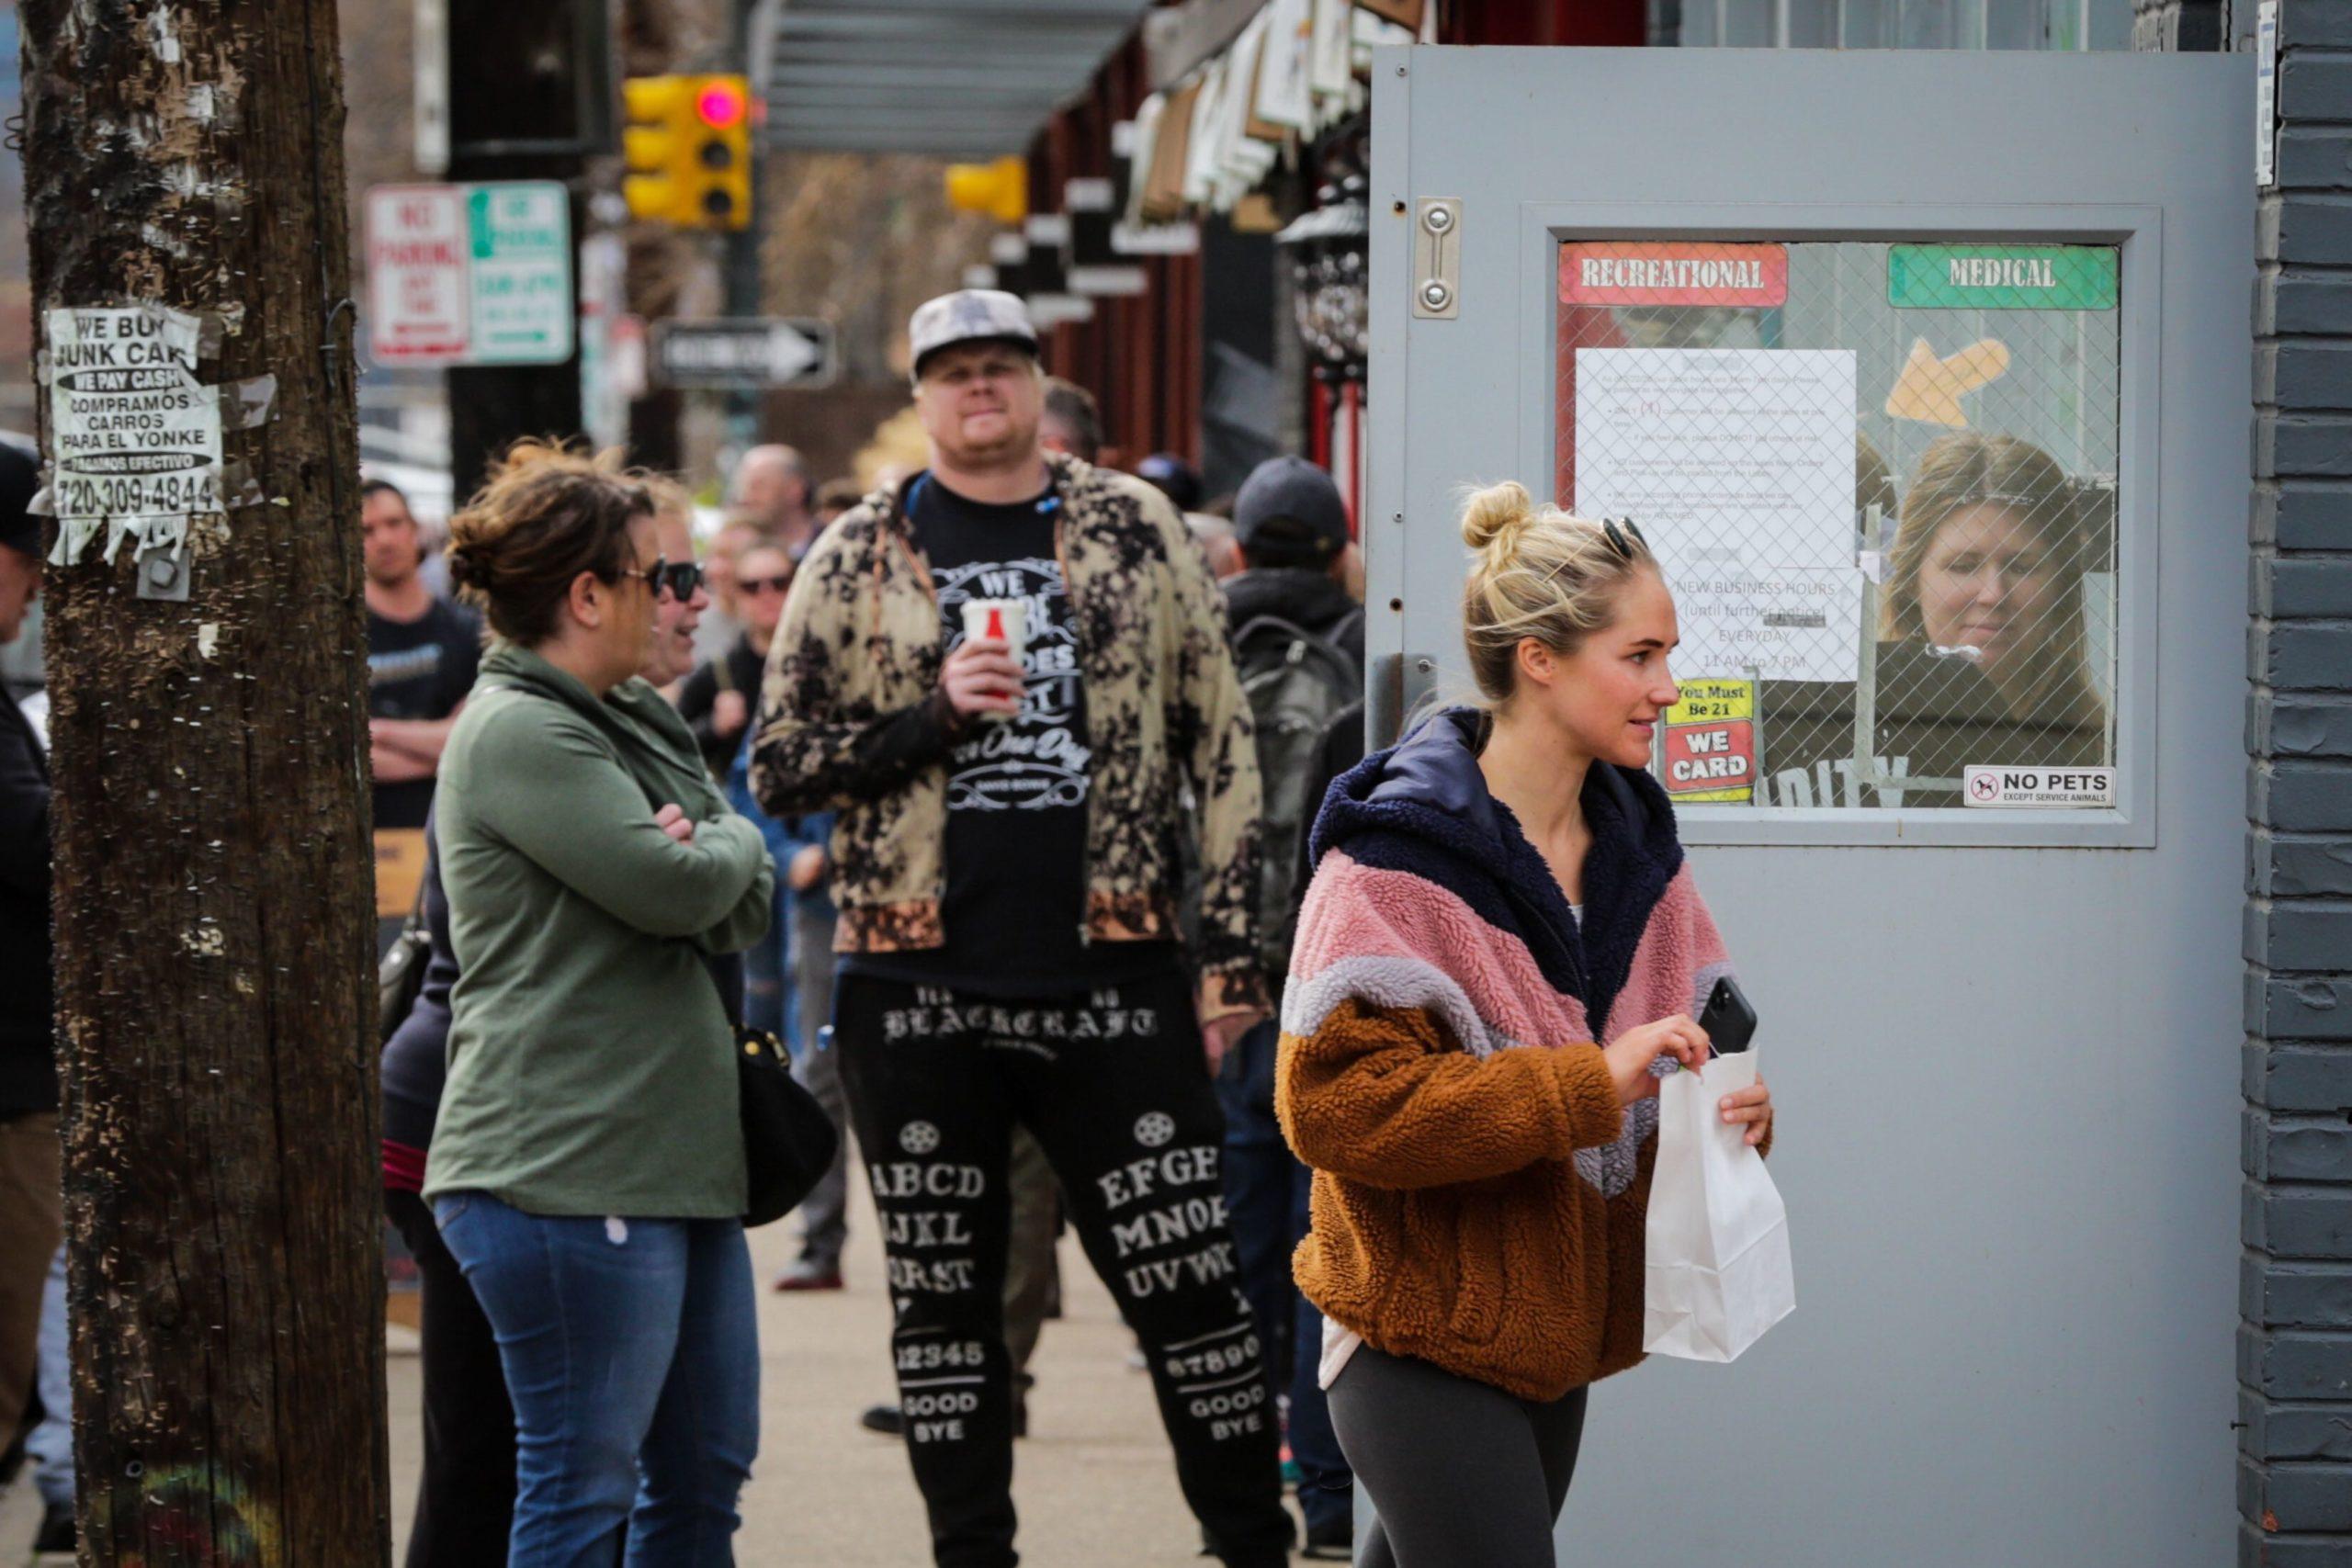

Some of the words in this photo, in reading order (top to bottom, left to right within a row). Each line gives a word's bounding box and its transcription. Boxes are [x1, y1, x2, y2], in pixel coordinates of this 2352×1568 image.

[1581, 258, 1765, 289] RECREATIONAL
[1950, 259, 2056, 288] MEDICAL
[75, 316, 107, 339] WE
[54, 343, 116, 367] JUNK
[74, 373, 96, 390] WE
[96, 373, 128, 390] PAY
[131, 369, 179, 389] CASH
[71, 393, 190, 413] COMPRAMOS
[87, 413, 164, 431] CARROS
[62, 433, 103, 449] PARA
[107, 433, 128, 448] EL
[134, 429, 206, 447] YONKE
[128, 454, 196, 471] EFECTIVO
[978, 570, 1027, 598] WE
[1676, 581, 1710, 594] NEW
[1714, 581, 1781, 595] BUSINESS
[1785, 582, 1836, 596] HOURS
[1684, 603, 1721, 617] (until
[1724, 604, 1772, 617] further
[1719, 629, 1791, 643] EVERYDAY
[1703, 655, 1720, 668] 11
[1724, 655, 1747, 668] AM
[1751, 657, 1767, 668] to
[1770, 656, 1779, 668] 7
[1782, 656, 1806, 669] PM
[1707, 685, 1746, 700] Must
[1688, 704, 1707, 716] Be
[1712, 702, 1730, 716] 21
[1685, 730, 1730, 754] WE
[1672, 755, 1747, 782] CARD
[2004, 773, 2039, 791] NO
[2047, 774, 2108, 791] PETS
[2004, 793, 2032, 801] EXCEPT
[2035, 794, 2068, 802] SERVICE
[903, 1392, 978, 1417] GOOD
[1189, 1383, 1266, 1418] GOOD
[913, 1419, 965, 1443] BYE
[1209, 1412, 1263, 1441] BYE
